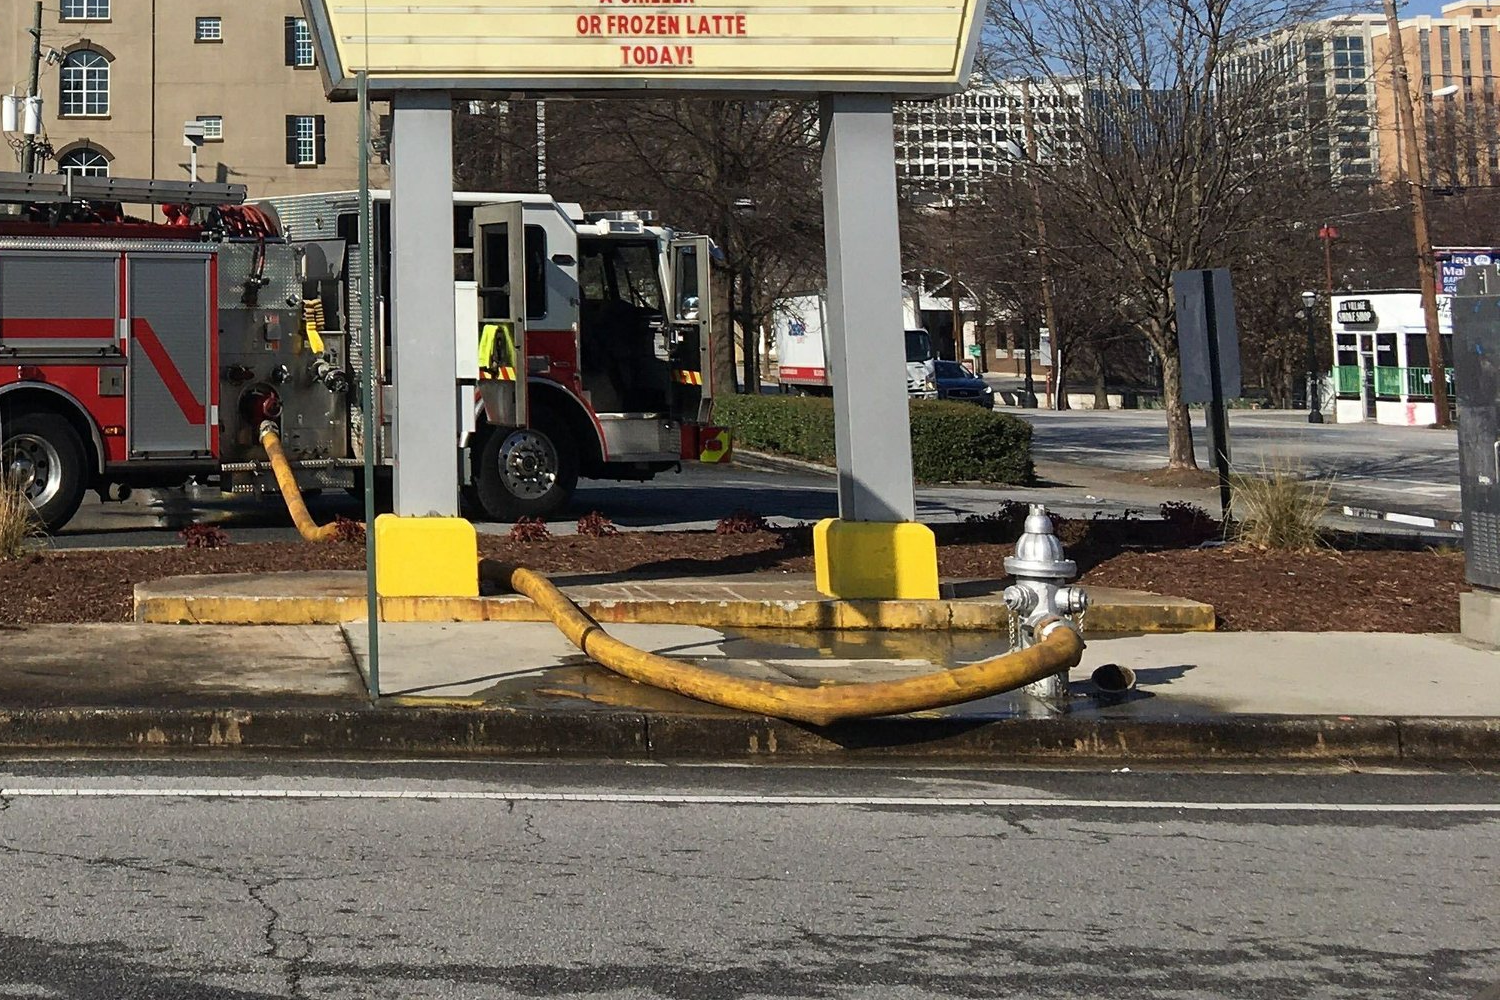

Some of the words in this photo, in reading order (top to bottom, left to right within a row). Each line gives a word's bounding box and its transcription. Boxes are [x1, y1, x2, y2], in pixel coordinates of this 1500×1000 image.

[576, 15, 601, 34] OR
[607, 15, 680, 35] FROZEN
[686, 15, 746, 35] LATTE
[620, 46, 693, 65] TODAY!
